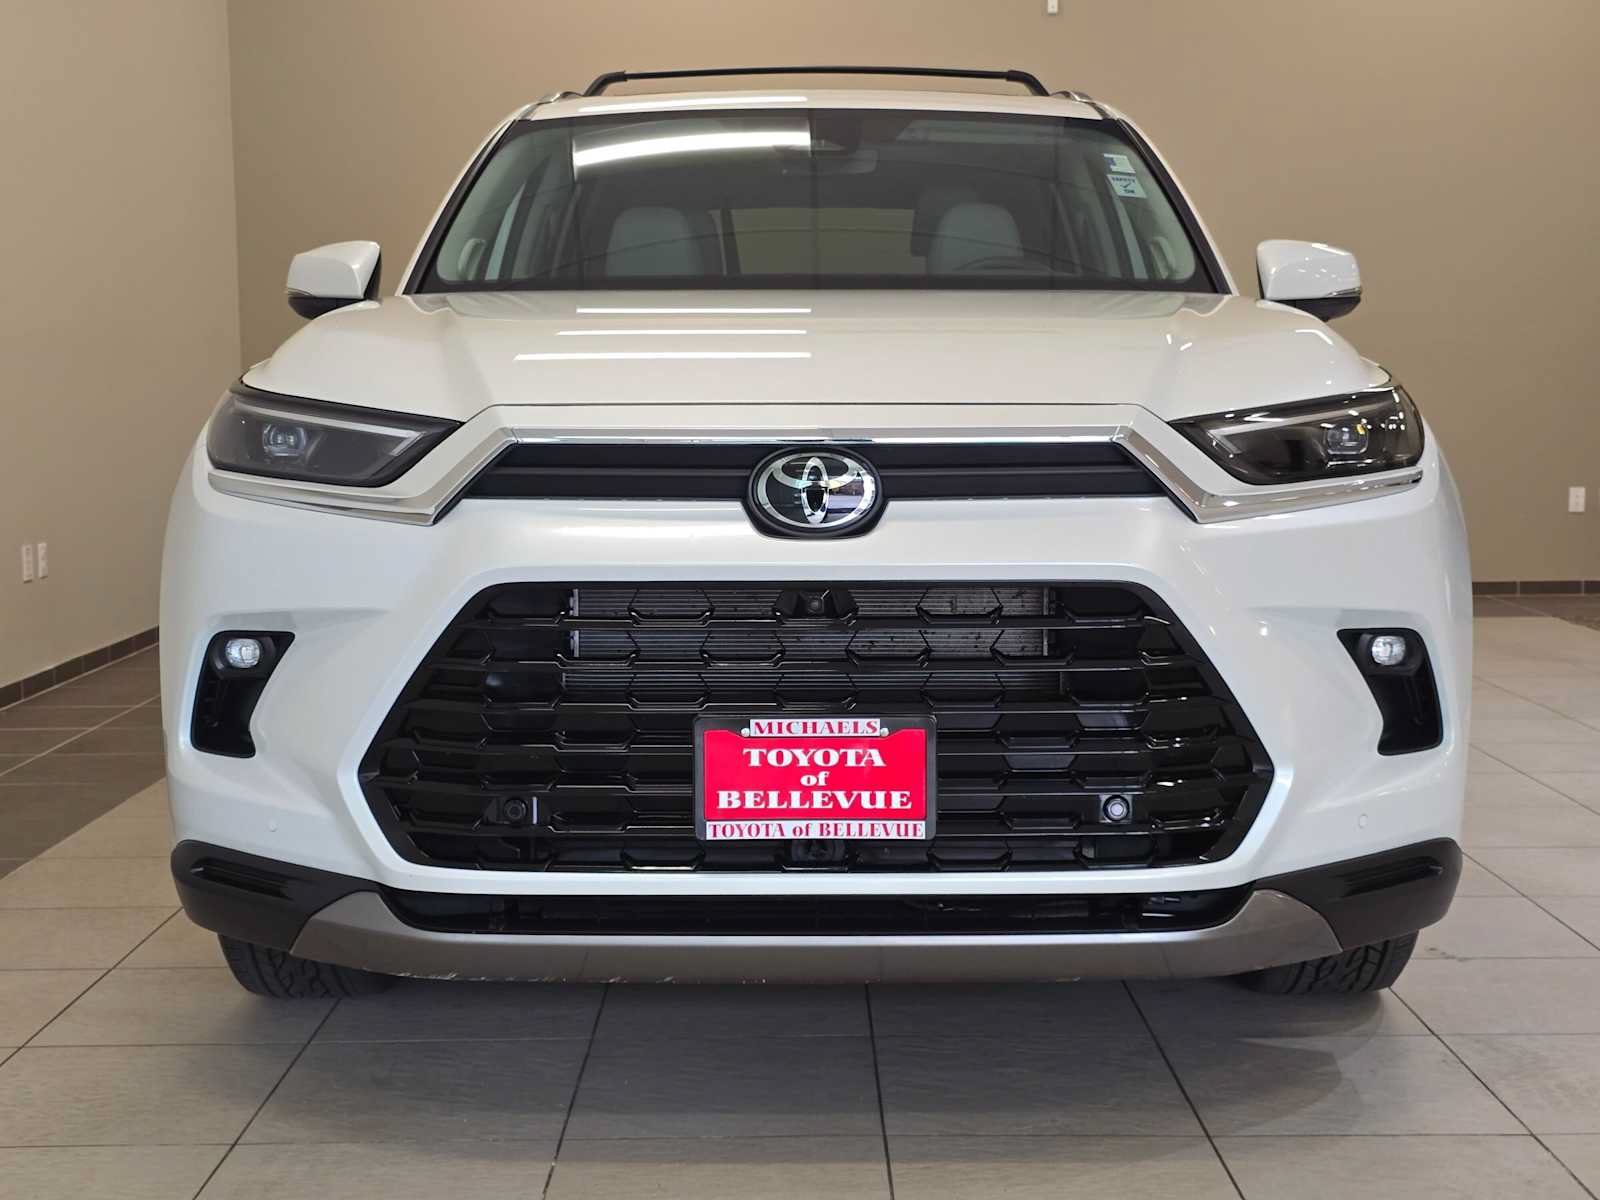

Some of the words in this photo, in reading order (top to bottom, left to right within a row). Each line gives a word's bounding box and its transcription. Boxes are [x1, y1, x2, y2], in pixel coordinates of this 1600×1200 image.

[754, 720, 878, 735] MICHAELS
[743, 748, 887, 767] TOYOTA
[800, 771, 829, 786] of
[717, 790, 912, 809] BELLEVUE
[708, 823, 785, 838] TOYOTA
[792, 823, 812, 838] of
[819, 822, 923, 838] BELLEVUE
